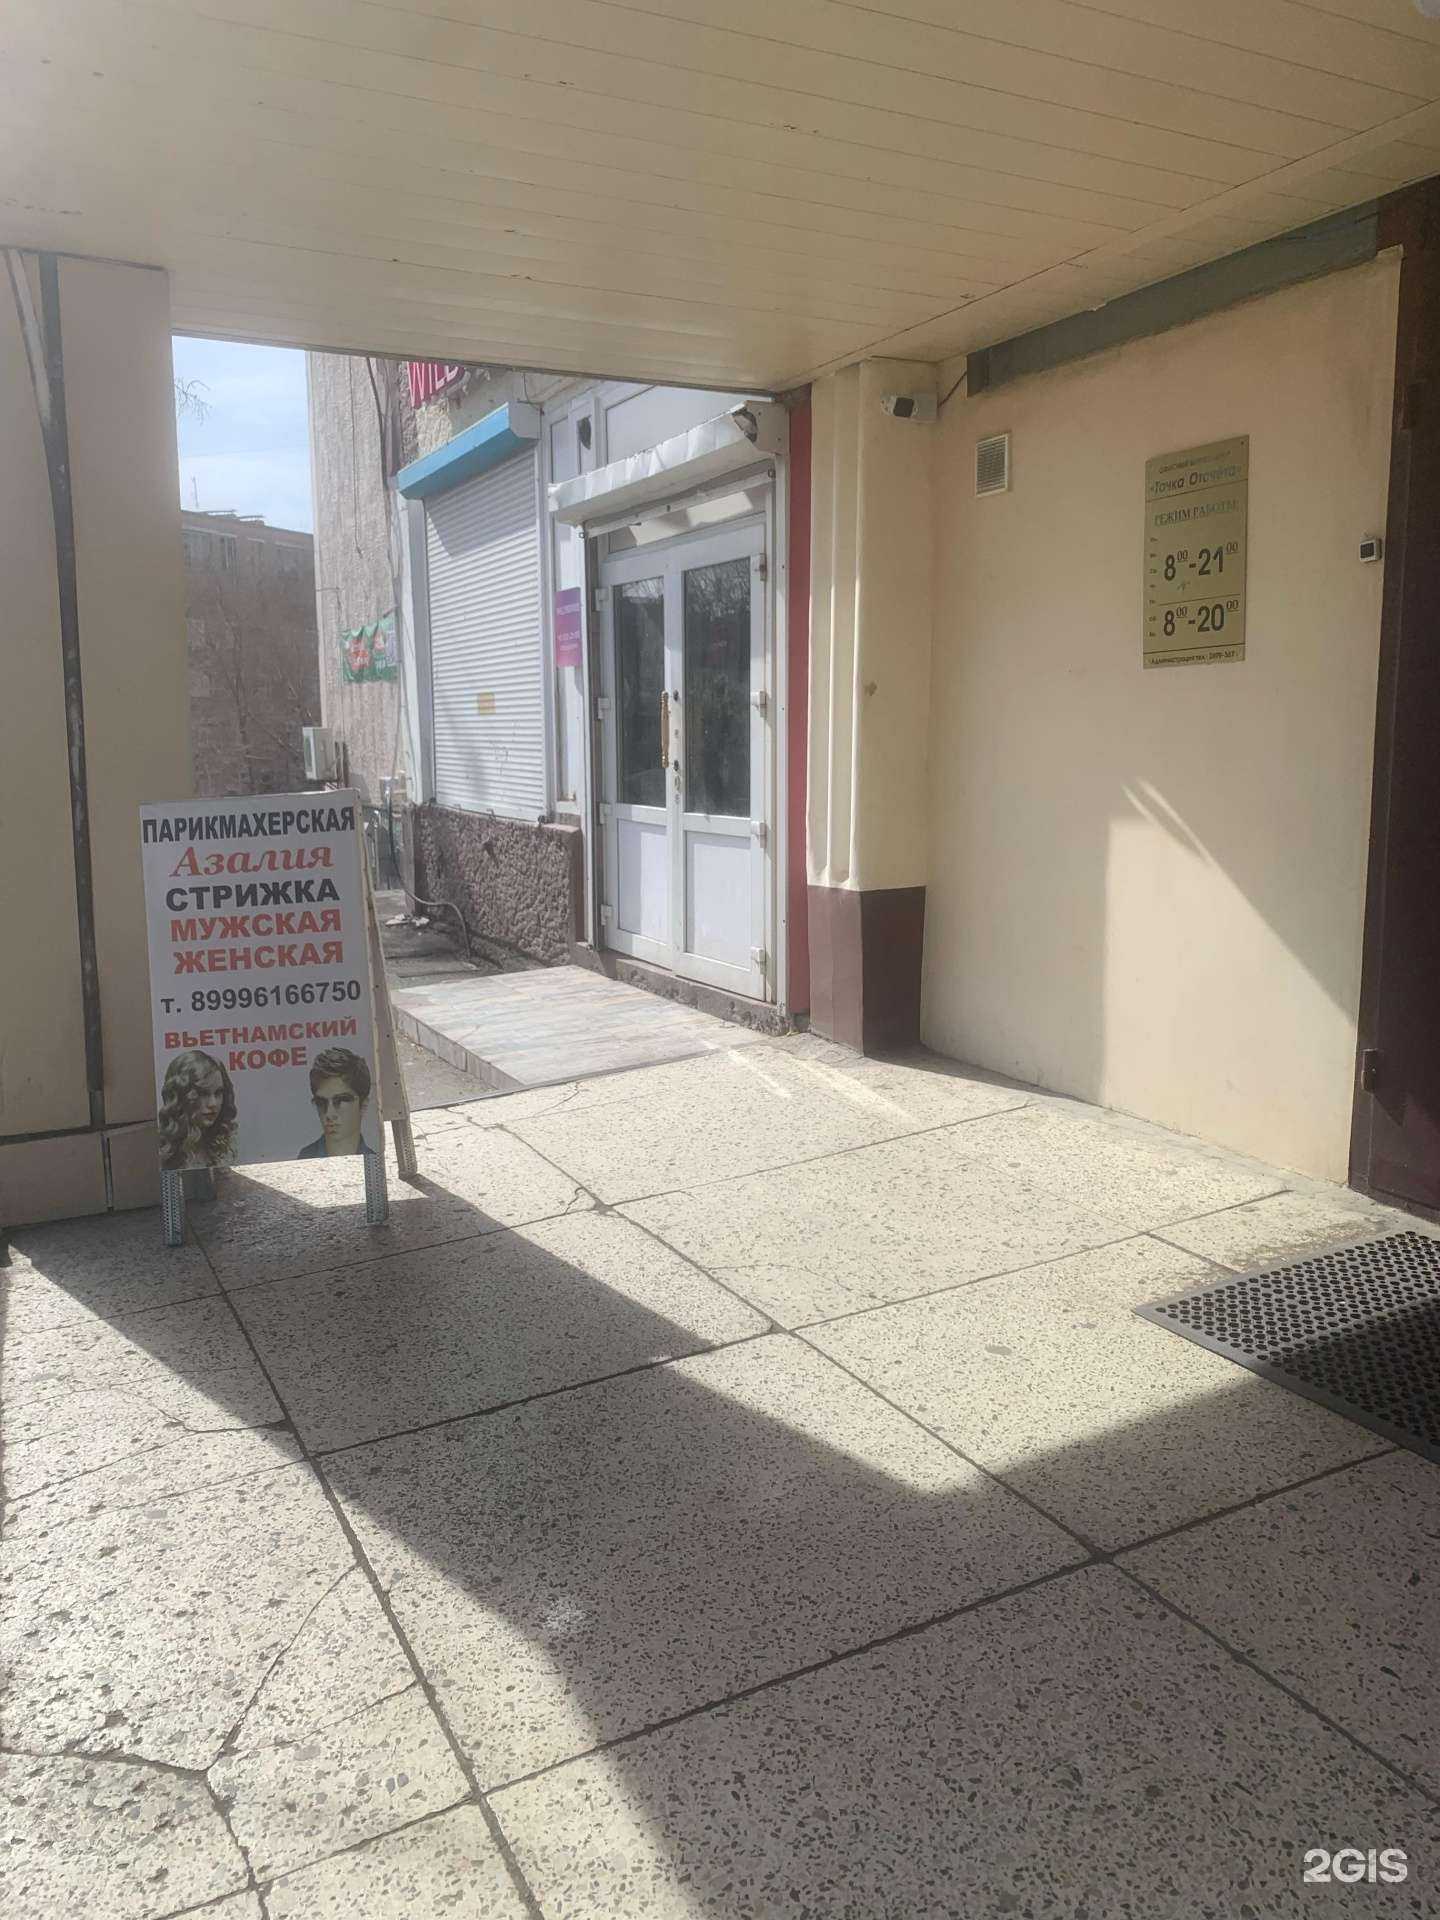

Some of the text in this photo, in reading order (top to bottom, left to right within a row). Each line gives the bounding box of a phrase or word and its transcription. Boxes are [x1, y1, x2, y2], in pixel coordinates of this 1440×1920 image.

[142, 806, 355, 843] ПАРИКМАХЕРСКАЯ
[168, 846, 335, 877] Азалия
[166, 878, 340, 912] СТРИЖКА
[170, 908, 342, 942] МУЖСКАЯ
[173, 940, 343, 974] ЖЕНСКАЯ
[191, 979, 361, 1012] 89996166750
[164, 1015, 357, 1049] ВЬЕТНАМСКИЙ
[229, 1046, 308, 1071] КОФЕ
